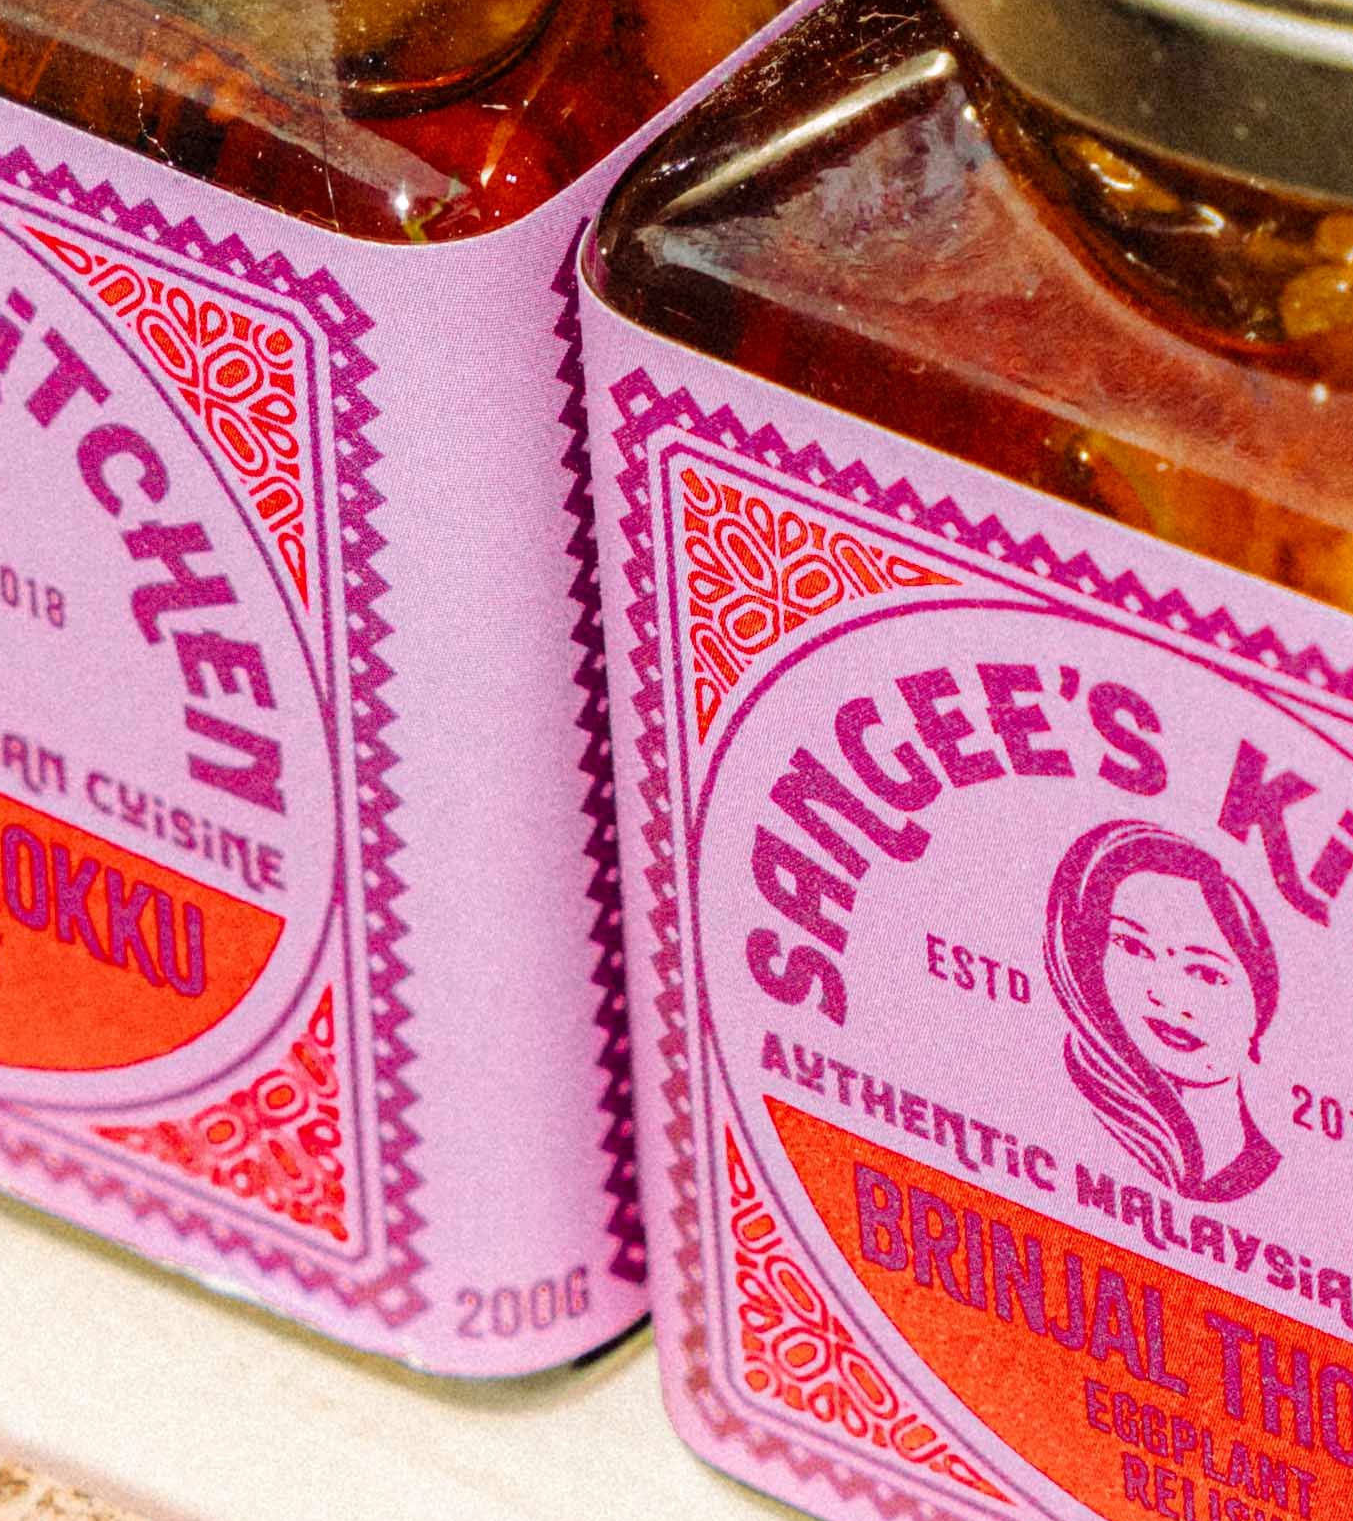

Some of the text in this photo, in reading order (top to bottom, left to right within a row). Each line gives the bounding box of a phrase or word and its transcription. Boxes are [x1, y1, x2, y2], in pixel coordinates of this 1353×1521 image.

[744, 663, 1169, 1028] SANGEE'S
[925, 931, 1033, 1005] ESTD
[457, 1263, 589, 1339] 200G
[852, 1161, 1189, 1398] BRINJAL
